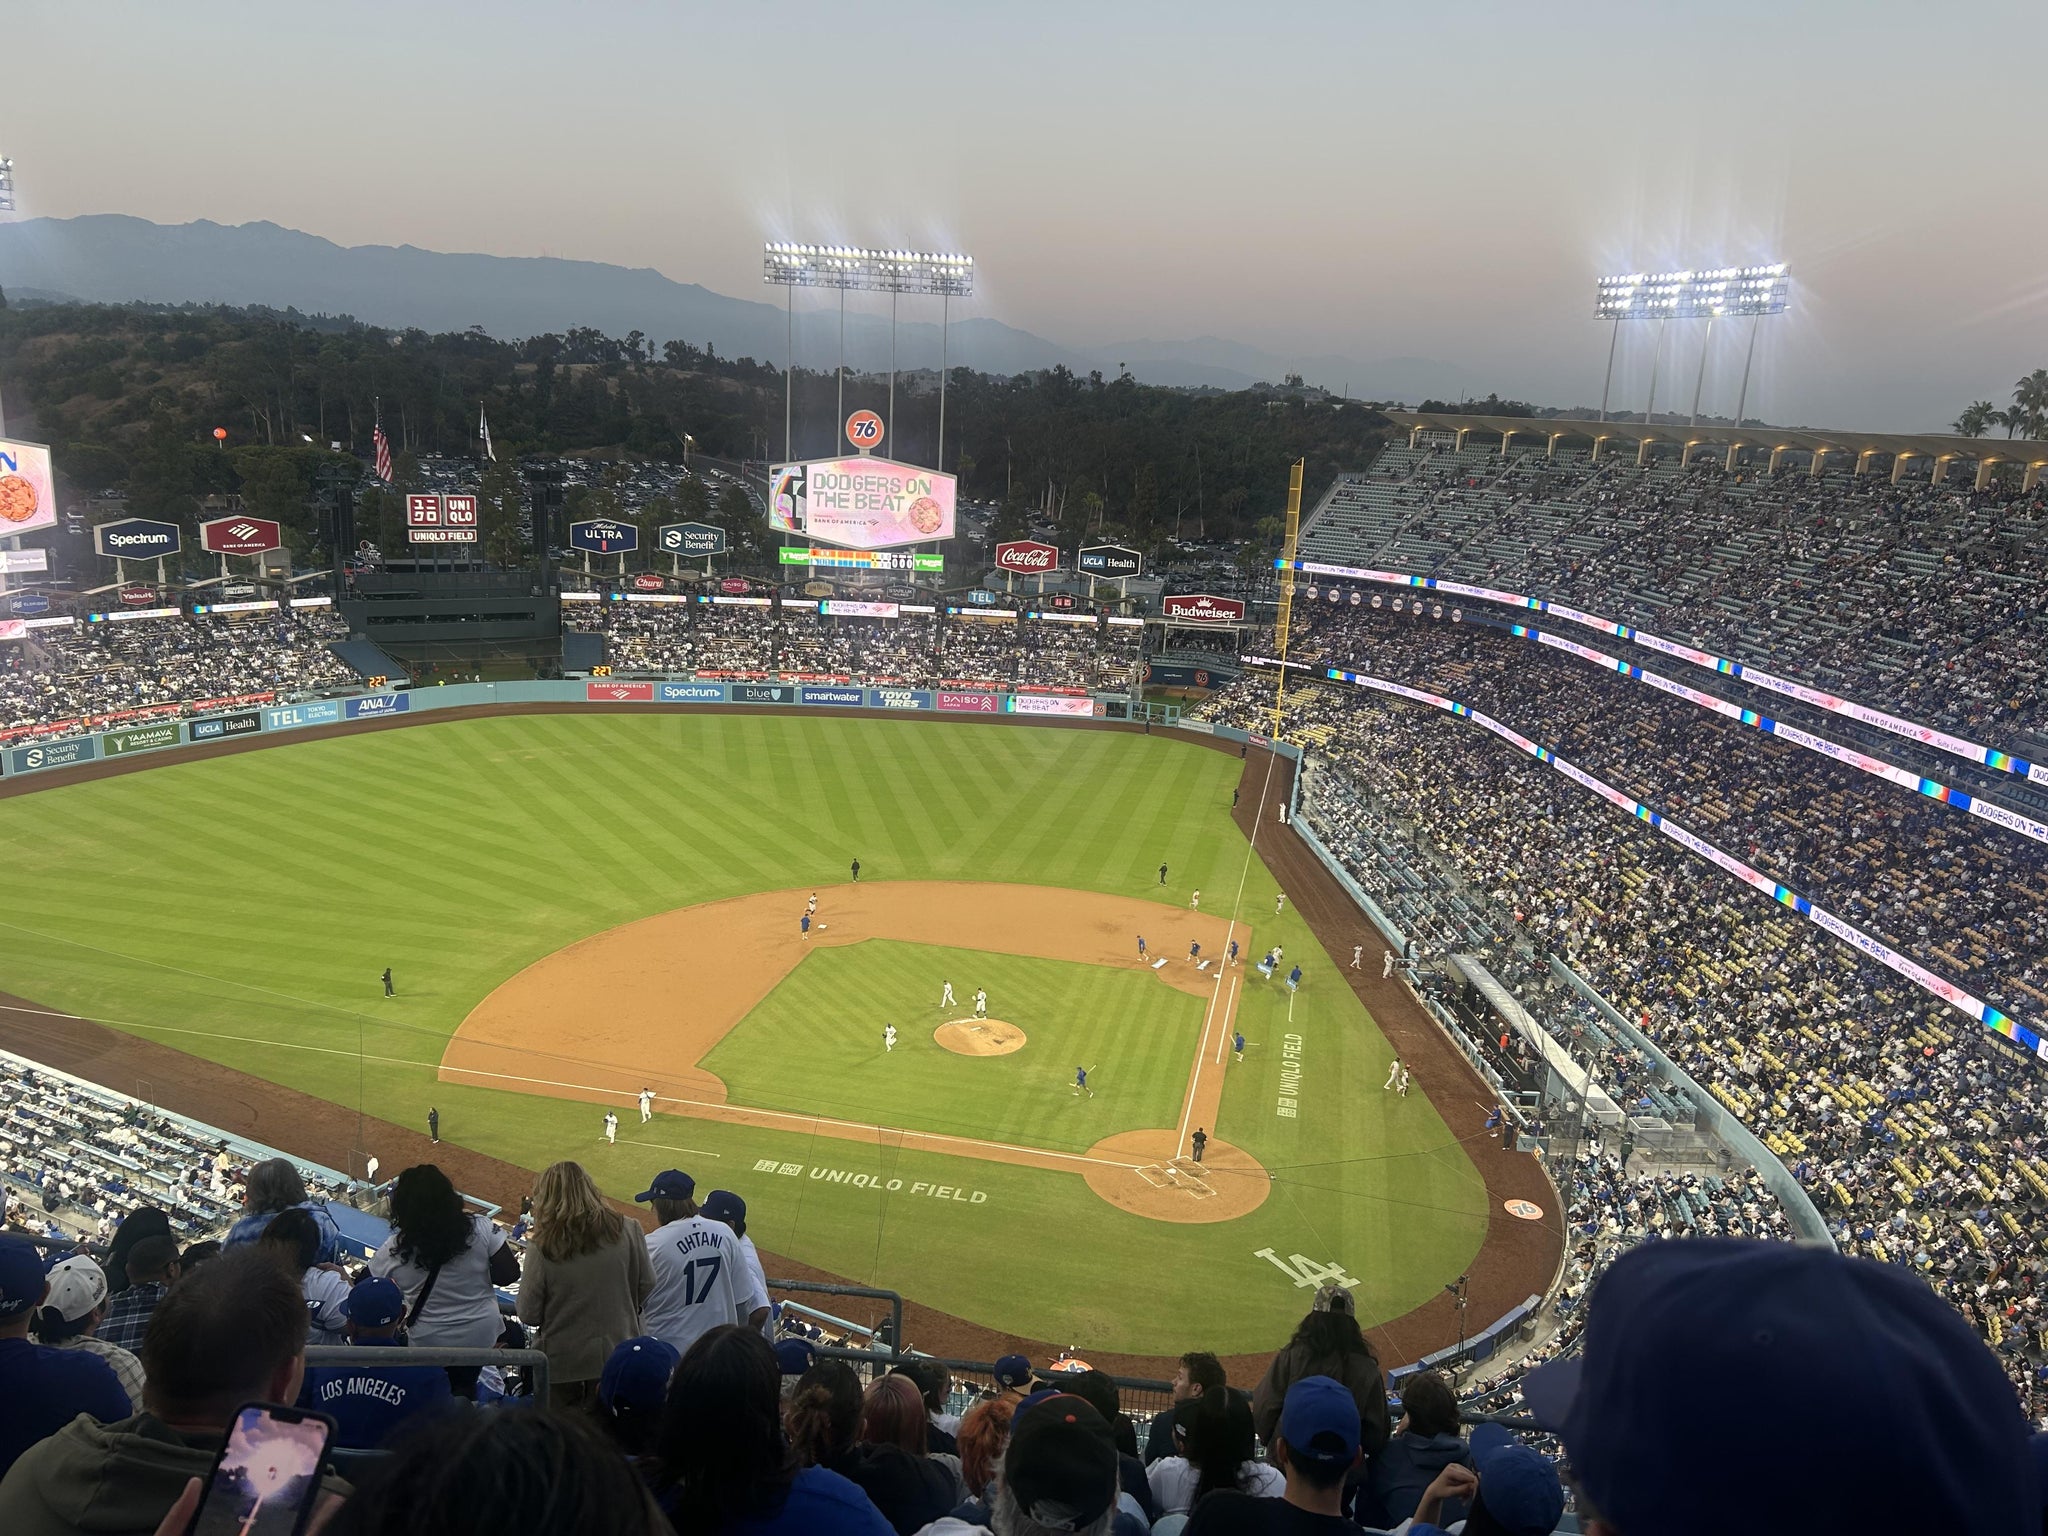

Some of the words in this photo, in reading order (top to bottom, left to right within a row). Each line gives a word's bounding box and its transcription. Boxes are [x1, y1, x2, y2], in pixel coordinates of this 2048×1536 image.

[854, 420, 877, 439] 76
[0, 451, 17, 472] N
[813, 473, 902, 495] DODGERS
[906, 478, 932, 495] ON
[813, 491, 849, 509] THE
[855, 493, 905, 512] BEAT
[109, 533, 168, 547] Spectrum
[414, 532, 446, 542] UNIQLO
[448, 532, 473, 540] FIELD
[585, 529, 623, 540] ULTRA
[684, 532, 719, 542] Security
[685, 540, 715, 550] Benefit
[1083, 557, 1103, 566] UCLA
[1107, 558, 1136, 569] Health
[971, 591, 992, 603] TEL
[1171, 604, 1236, 619] Budweiser
[1196, 672, 1207, 683] 76
[664, 686, 716, 699] Spectrum
[746, 688, 771, 698] blue
[805, 692, 860, 703] smartwater
[879, 691, 912, 699] TOYO
[358, 698, 384, 711] ANA
[884, 699, 919, 708] TIRES
[943, 695, 979, 705] DAISO
[307, 705, 326, 713] TOKYO
[270, 709, 302, 726] TEL
[198, 725, 221, 734] UCLA
[225, 719, 255, 731] Health
[1862, 713, 1879, 726] BANK
[1880, 718, 1888, 728] OF
[1888, 720, 1918, 738] AMERICA
[45, 744, 80, 755] Security
[47, 753, 77, 764] Benefit
[1976, 803, 2014, 825] DODGERS
[2014, 819, 2026, 832] ON
[2028, 822, 2045, 838] THE
[1814, 910, 1844, 935] DODGERS
[1845, 928, 1854, 940] ON
[1855, 934, 1870, 949] THE
[1870, 941, 1891, 961] BEAT
[1283, 1033, 1303, 1060] FIELD
[1279, 1061, 1303, 1096] UNIQLO
[809, 1167, 903, 1191] UNIQLO
[909, 1181, 988, 1204] FIELD
[1511, 1202, 1538, 1217] 76
[676, 1231, 723, 1255] OHTANI
[1253, 1247, 1361, 1295] LA
[683, 1256, 721, 1306] 17
[320, 1379, 343, 1401] LOS
[346, 1377, 406, 1406] ANGELES
